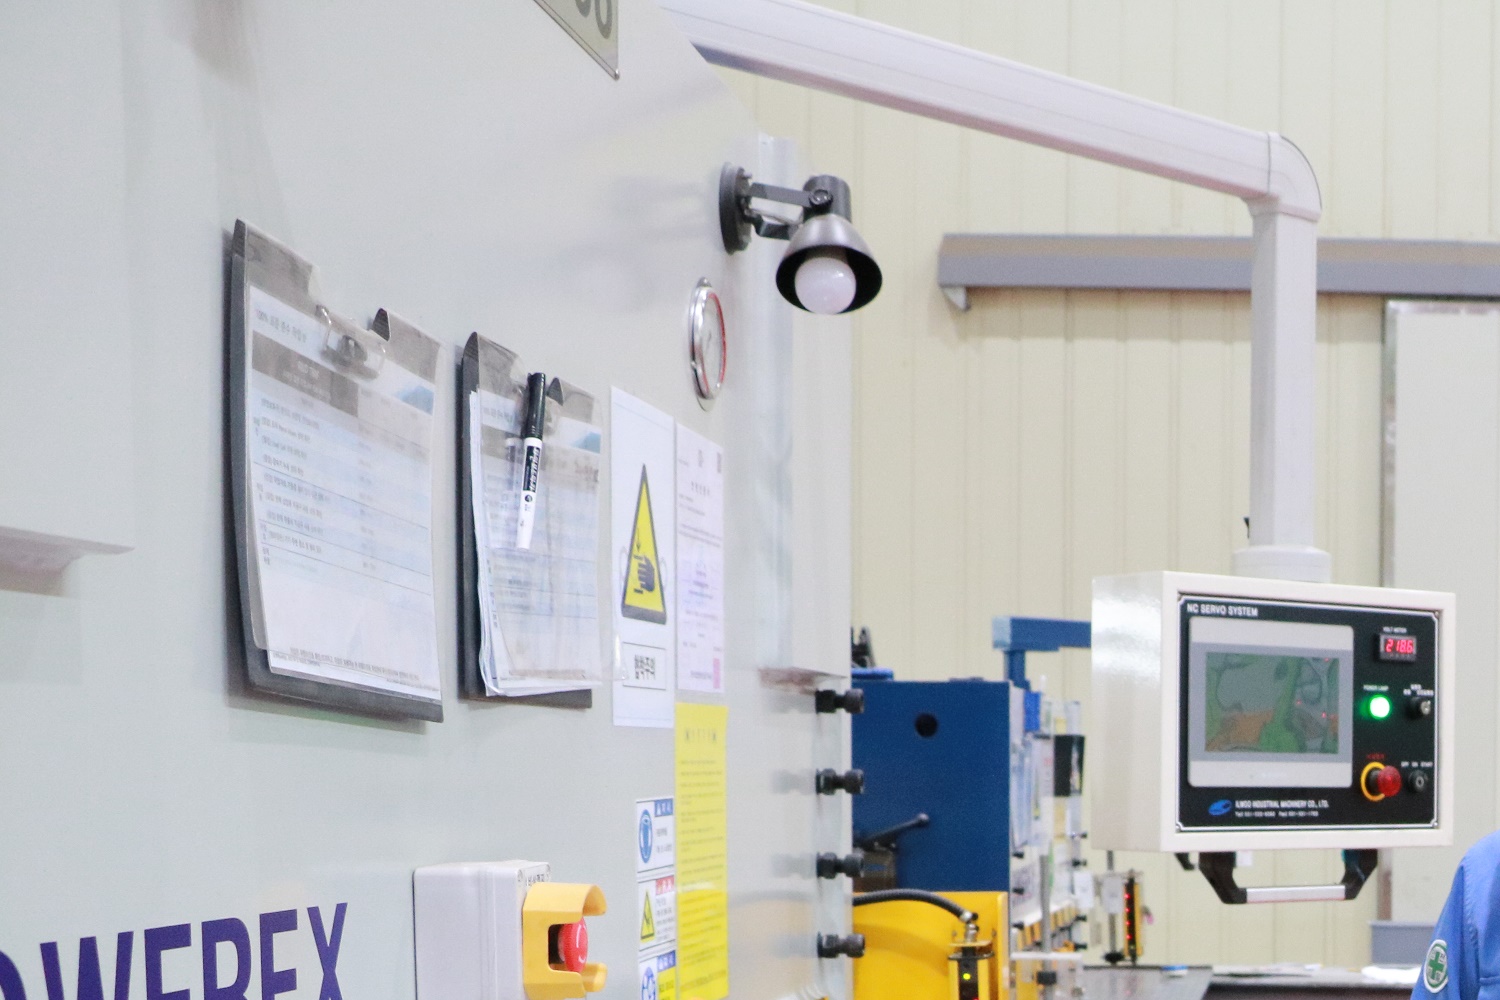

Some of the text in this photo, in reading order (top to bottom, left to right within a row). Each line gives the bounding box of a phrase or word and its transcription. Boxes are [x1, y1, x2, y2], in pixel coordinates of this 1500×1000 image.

[1187, 603, 1258, 616] NC SERVO SYSTEM
